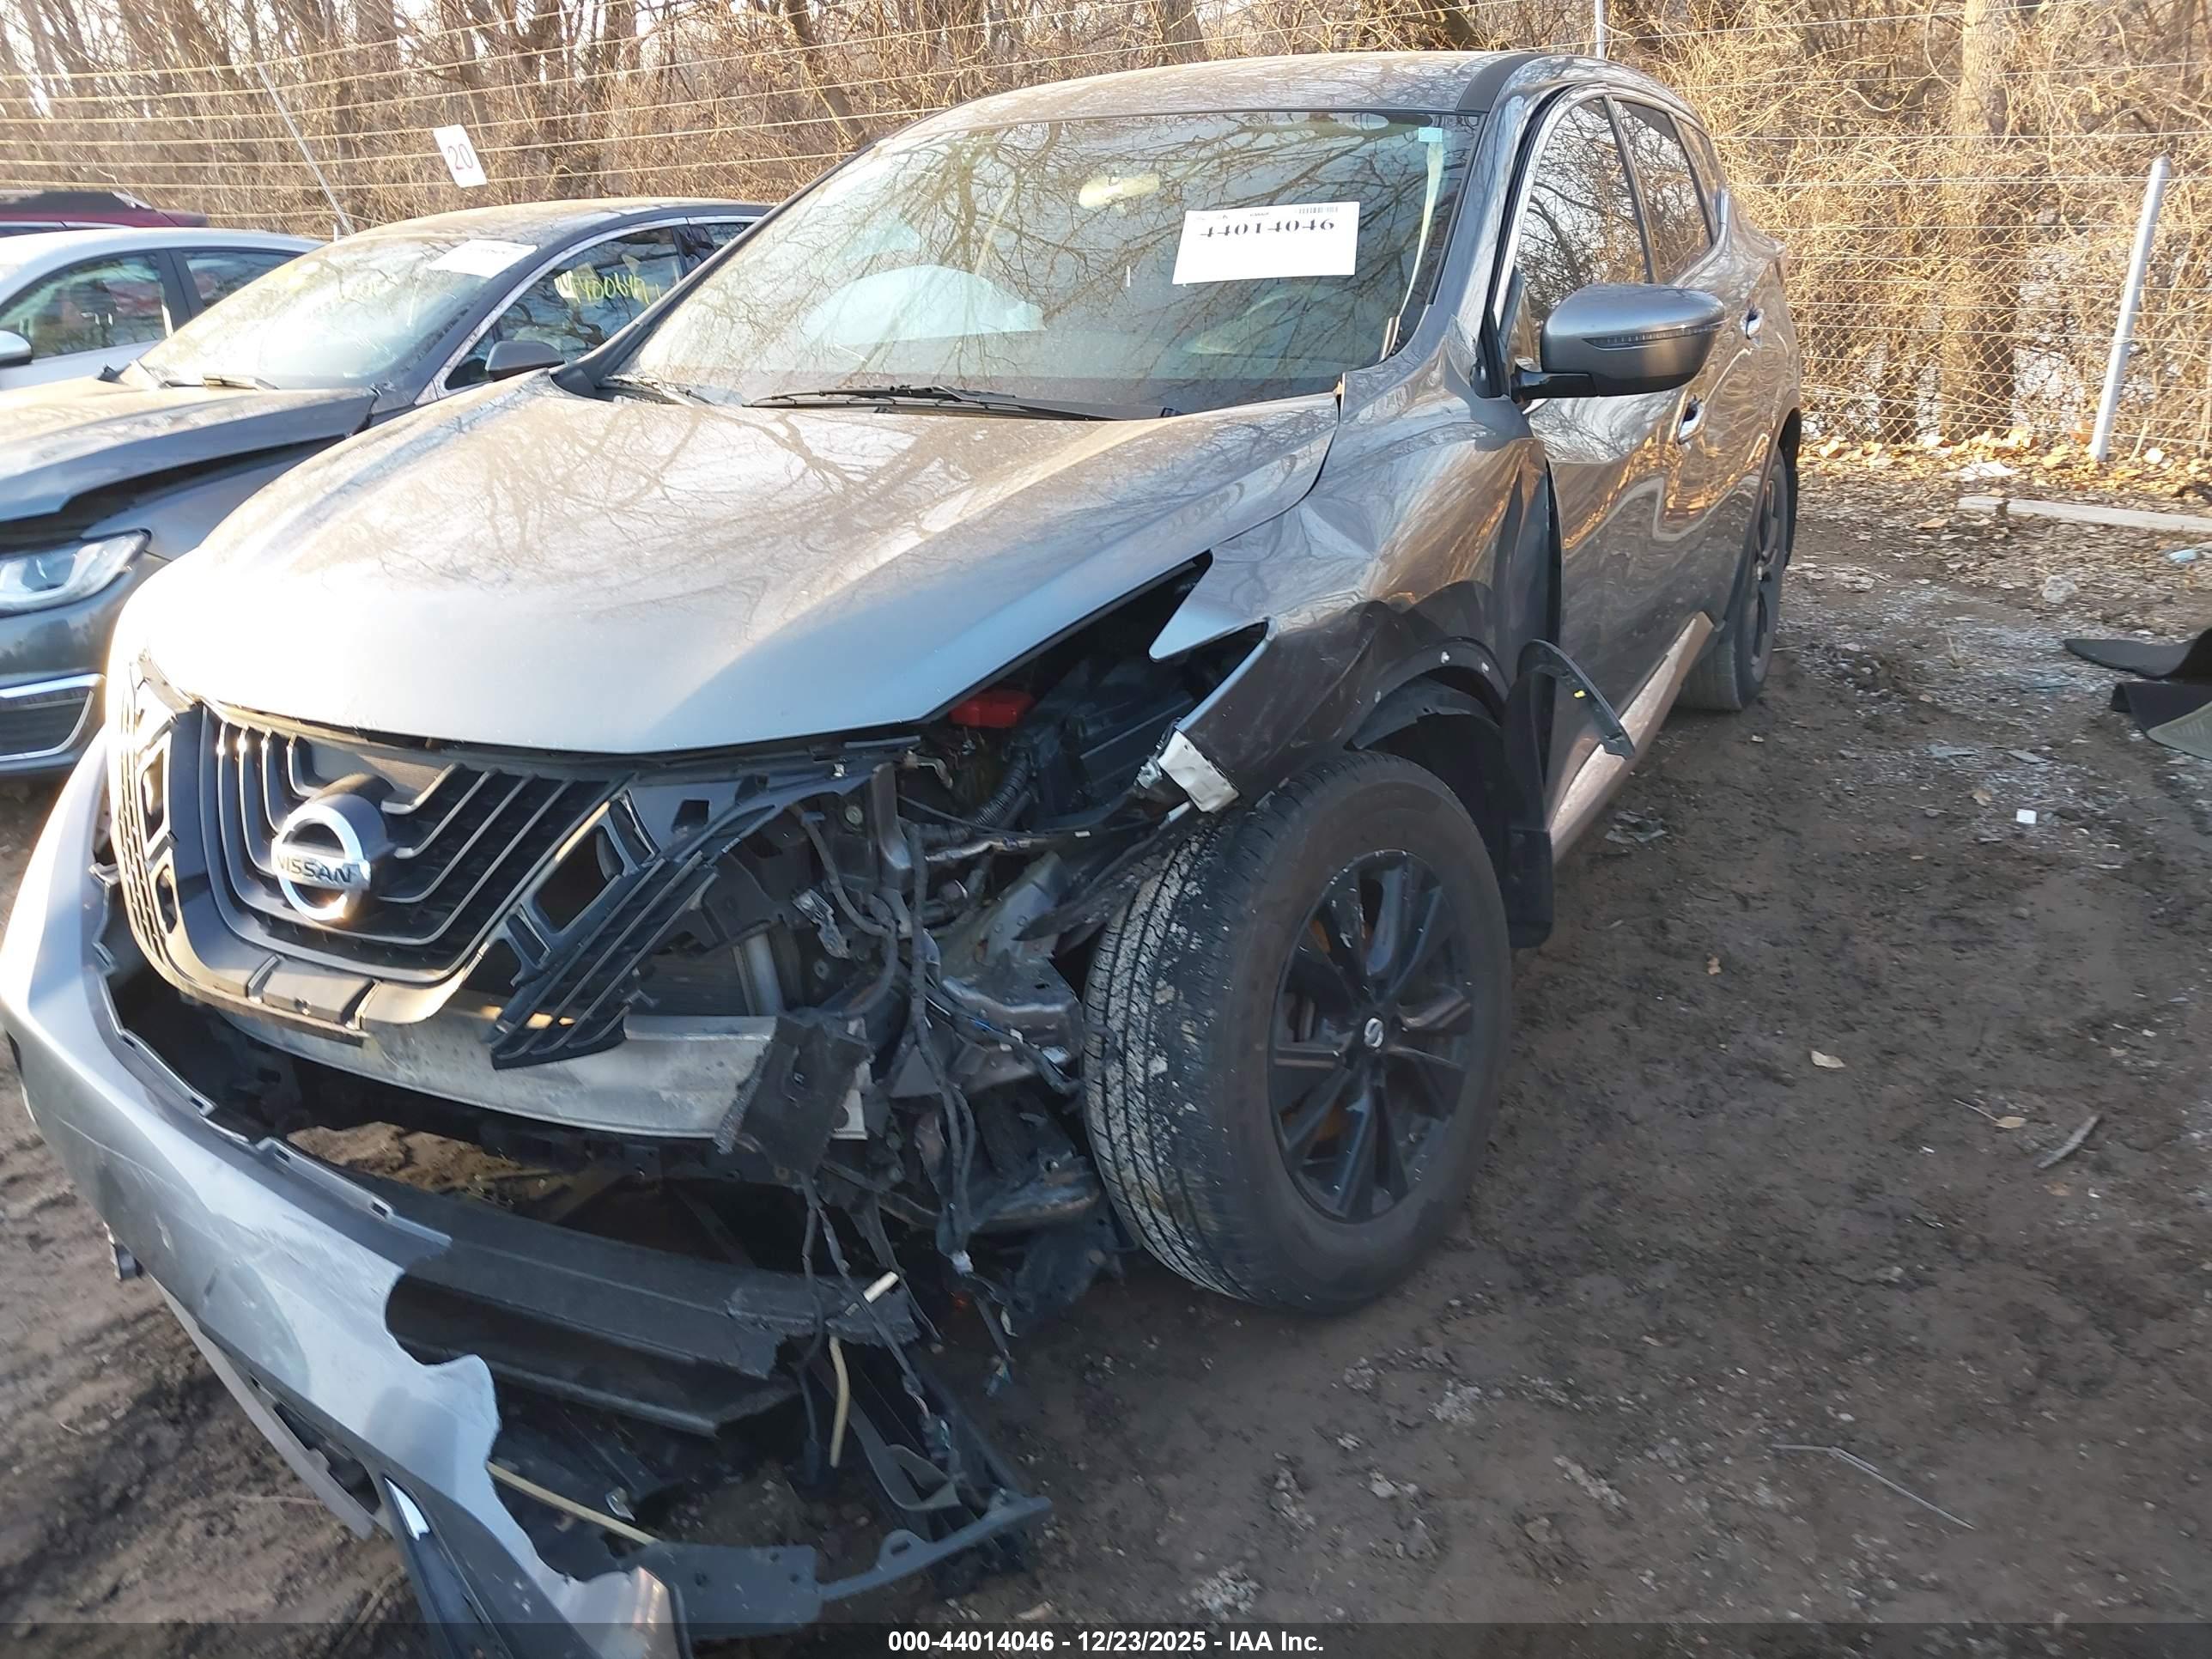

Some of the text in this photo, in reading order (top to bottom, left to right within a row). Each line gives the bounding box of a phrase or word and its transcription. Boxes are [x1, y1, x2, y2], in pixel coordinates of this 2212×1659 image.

[447, 143, 473, 170] 20
[1200, 218, 1335, 238] 44014046
[276, 854, 351, 883] NISSAN
